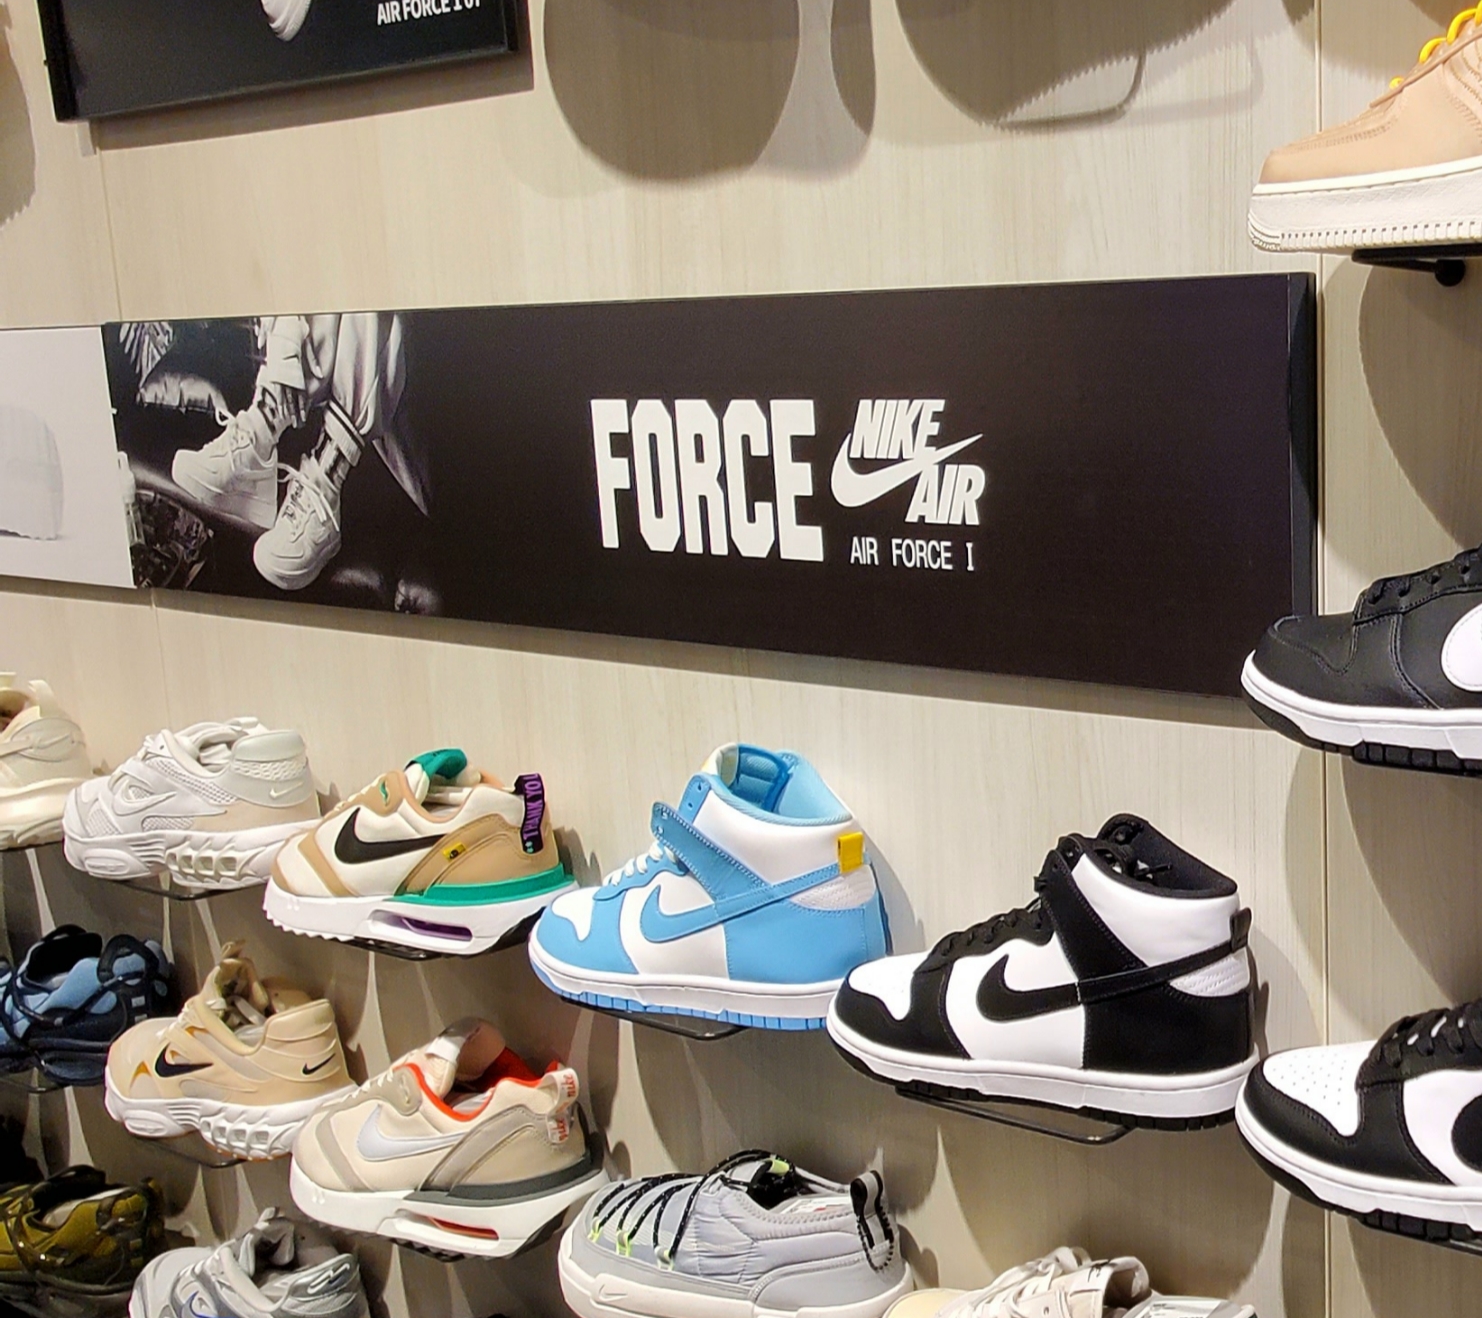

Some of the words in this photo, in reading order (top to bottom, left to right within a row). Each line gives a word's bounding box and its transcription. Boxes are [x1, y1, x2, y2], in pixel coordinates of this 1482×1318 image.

[377, 0, 402, 26] AIR
[849, 398, 946, 460] NIKE
[590, 398, 825, 563] FORCE
[904, 464, 986, 526] AIR
[849, 536, 880, 566] AIR
[891, 538, 953, 571] FORCE
[523, 799, 543, 841] THANK
